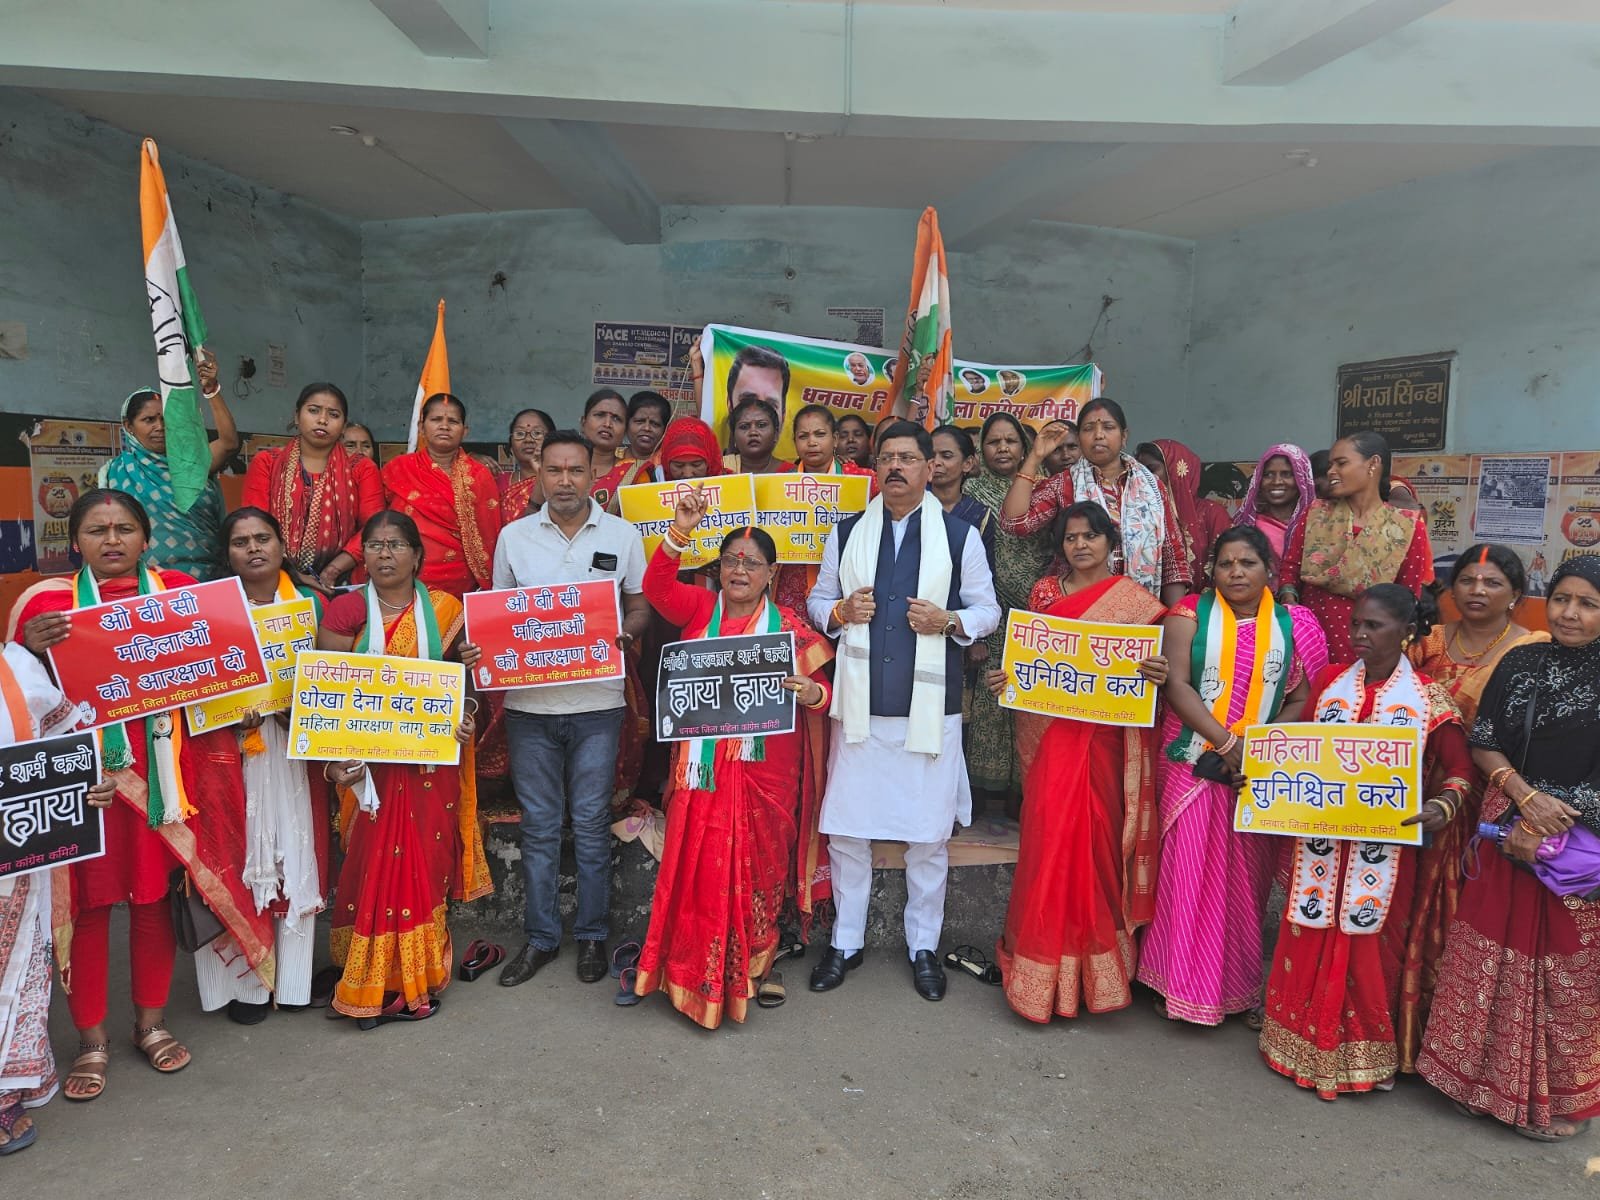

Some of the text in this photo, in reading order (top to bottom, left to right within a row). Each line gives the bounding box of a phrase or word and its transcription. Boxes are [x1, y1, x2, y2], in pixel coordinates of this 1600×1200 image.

[597, 325, 629, 340] PACE
[674, 331, 698, 344] PAC
[803, 388, 867, 409] धनबाद
[1343, 379, 1444, 408] श्री राज सिन्हा
[1028, 399, 1078, 419] कमिटी
[785, 476, 840, 505] महिला
[44, 520, 69, 536] ABV
[756, 511, 807, 526] आरक्षण
[790, 533, 816, 549] लागू
[102, 592, 198, 630] ओ बी सी
[507, 587, 579, 611] ओ बी सी
[264, 615, 291, 632] नाम
[297, 611, 312, 626] पर
[513, 615, 584, 641] महिलाओं
[116, 621, 209, 662] महिलाओं
[262, 632, 314, 661] बंद करो
[495, 640, 608, 670] को आरक्षण दो
[1014, 619, 1155, 666] महिला सुरक्षा
[663, 642, 790, 671] मोदी सरकार शर्म करो
[99, 647, 245, 701] को आरक्षण दो
[303, 660, 457, 689] परिसीमन के नाम पर
[499, 676, 522, 684] धनबाद
[525, 673, 543, 683] जिला
[547, 671, 568, 681] महिला
[595, 665, 616, 675] कमिटी
[1015, 659, 1148, 697] सुनिश्चित करो
[107, 703, 140, 719] धनबाद
[143, 696, 167, 710] जिला
[170, 689, 198, 703] महिला
[201, 681, 228, 695] कांग्रेस
[231, 673, 259, 687] कमिटी
[300, 686, 453, 714] धोखा देना बंद करो
[668, 671, 787, 717] हाय हाय
[1022, 699, 1044, 709] धनबाद
[1046, 702, 1064, 713] जिला
[1066, 705, 1088, 717] महिला
[1113, 711, 1136, 721] कमिटी
[300, 714, 452, 738] महिला आरक्षण लागू करो
[679, 725, 700, 734] धनबाद
[701, 724, 718, 734] जिला
[720, 723, 739, 734] महिला
[761, 718, 780, 729] कमिटी
[10, 752, 47, 783] शर्म
[52, 744, 92, 775] करो
[317, 746, 342, 755] धनबाद
[345, 745, 365, 756] जिला
[367, 746, 390, 757] महिला
[416, 748, 439, 758] कमिटी
[1250, 730, 1412, 774] महिला सुरक्षा
[1252, 771, 1408, 809] सुनिश्चित करो
[0, 782, 88, 848] हाय
[1260, 819, 1397, 836] धनबाद जिला महिला कांग्रेस कमिटी
[16, 854, 44, 869] कांग्रेस
[50, 845, 79, 860] कमिटी
